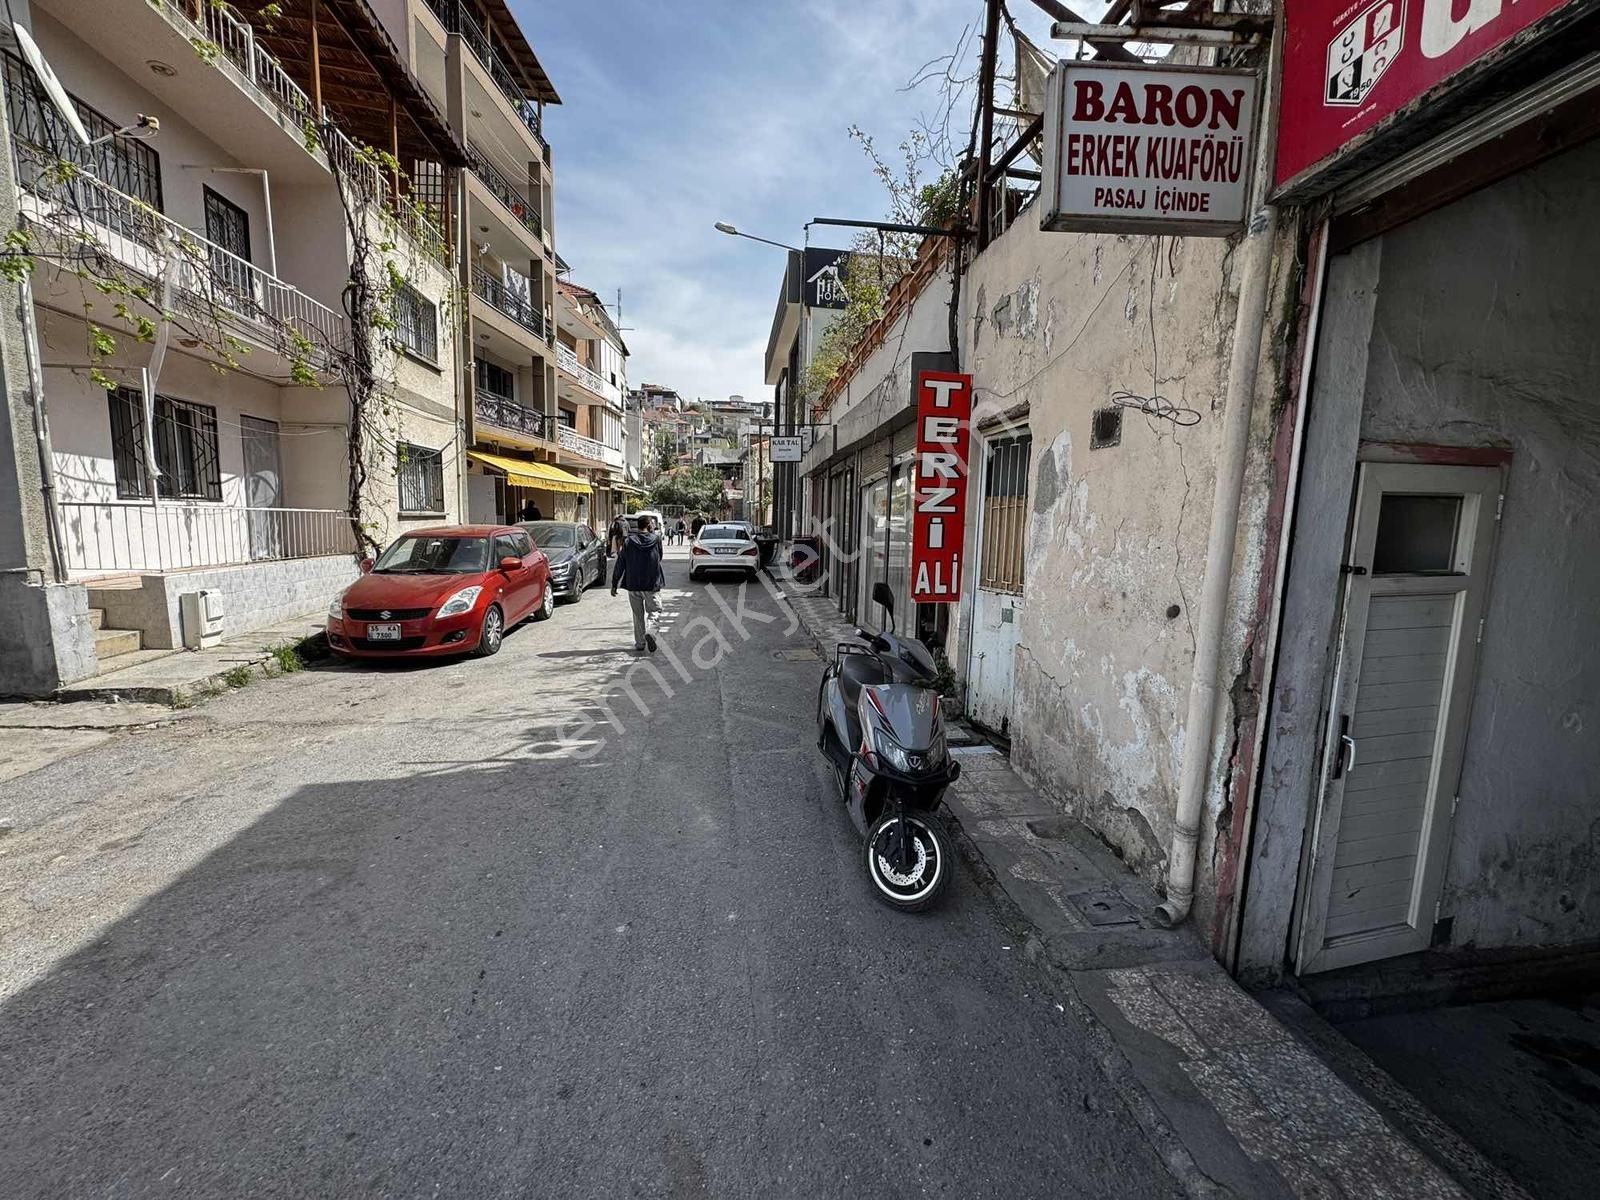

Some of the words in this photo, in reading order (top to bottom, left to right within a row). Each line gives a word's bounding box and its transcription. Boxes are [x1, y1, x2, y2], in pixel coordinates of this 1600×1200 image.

[1072, 80, 1245, 131] BARON
[1067, 133, 1141, 178] ERKEK
[1145, 133, 1243, 183] KUAFÖRÜ
[1094, 187, 1146, 210] PASAJ
[1154, 185, 1210, 214] İÇİNDE
[917, 379, 964, 549] TERZİ
[914, 553, 959, 595] ALİ
